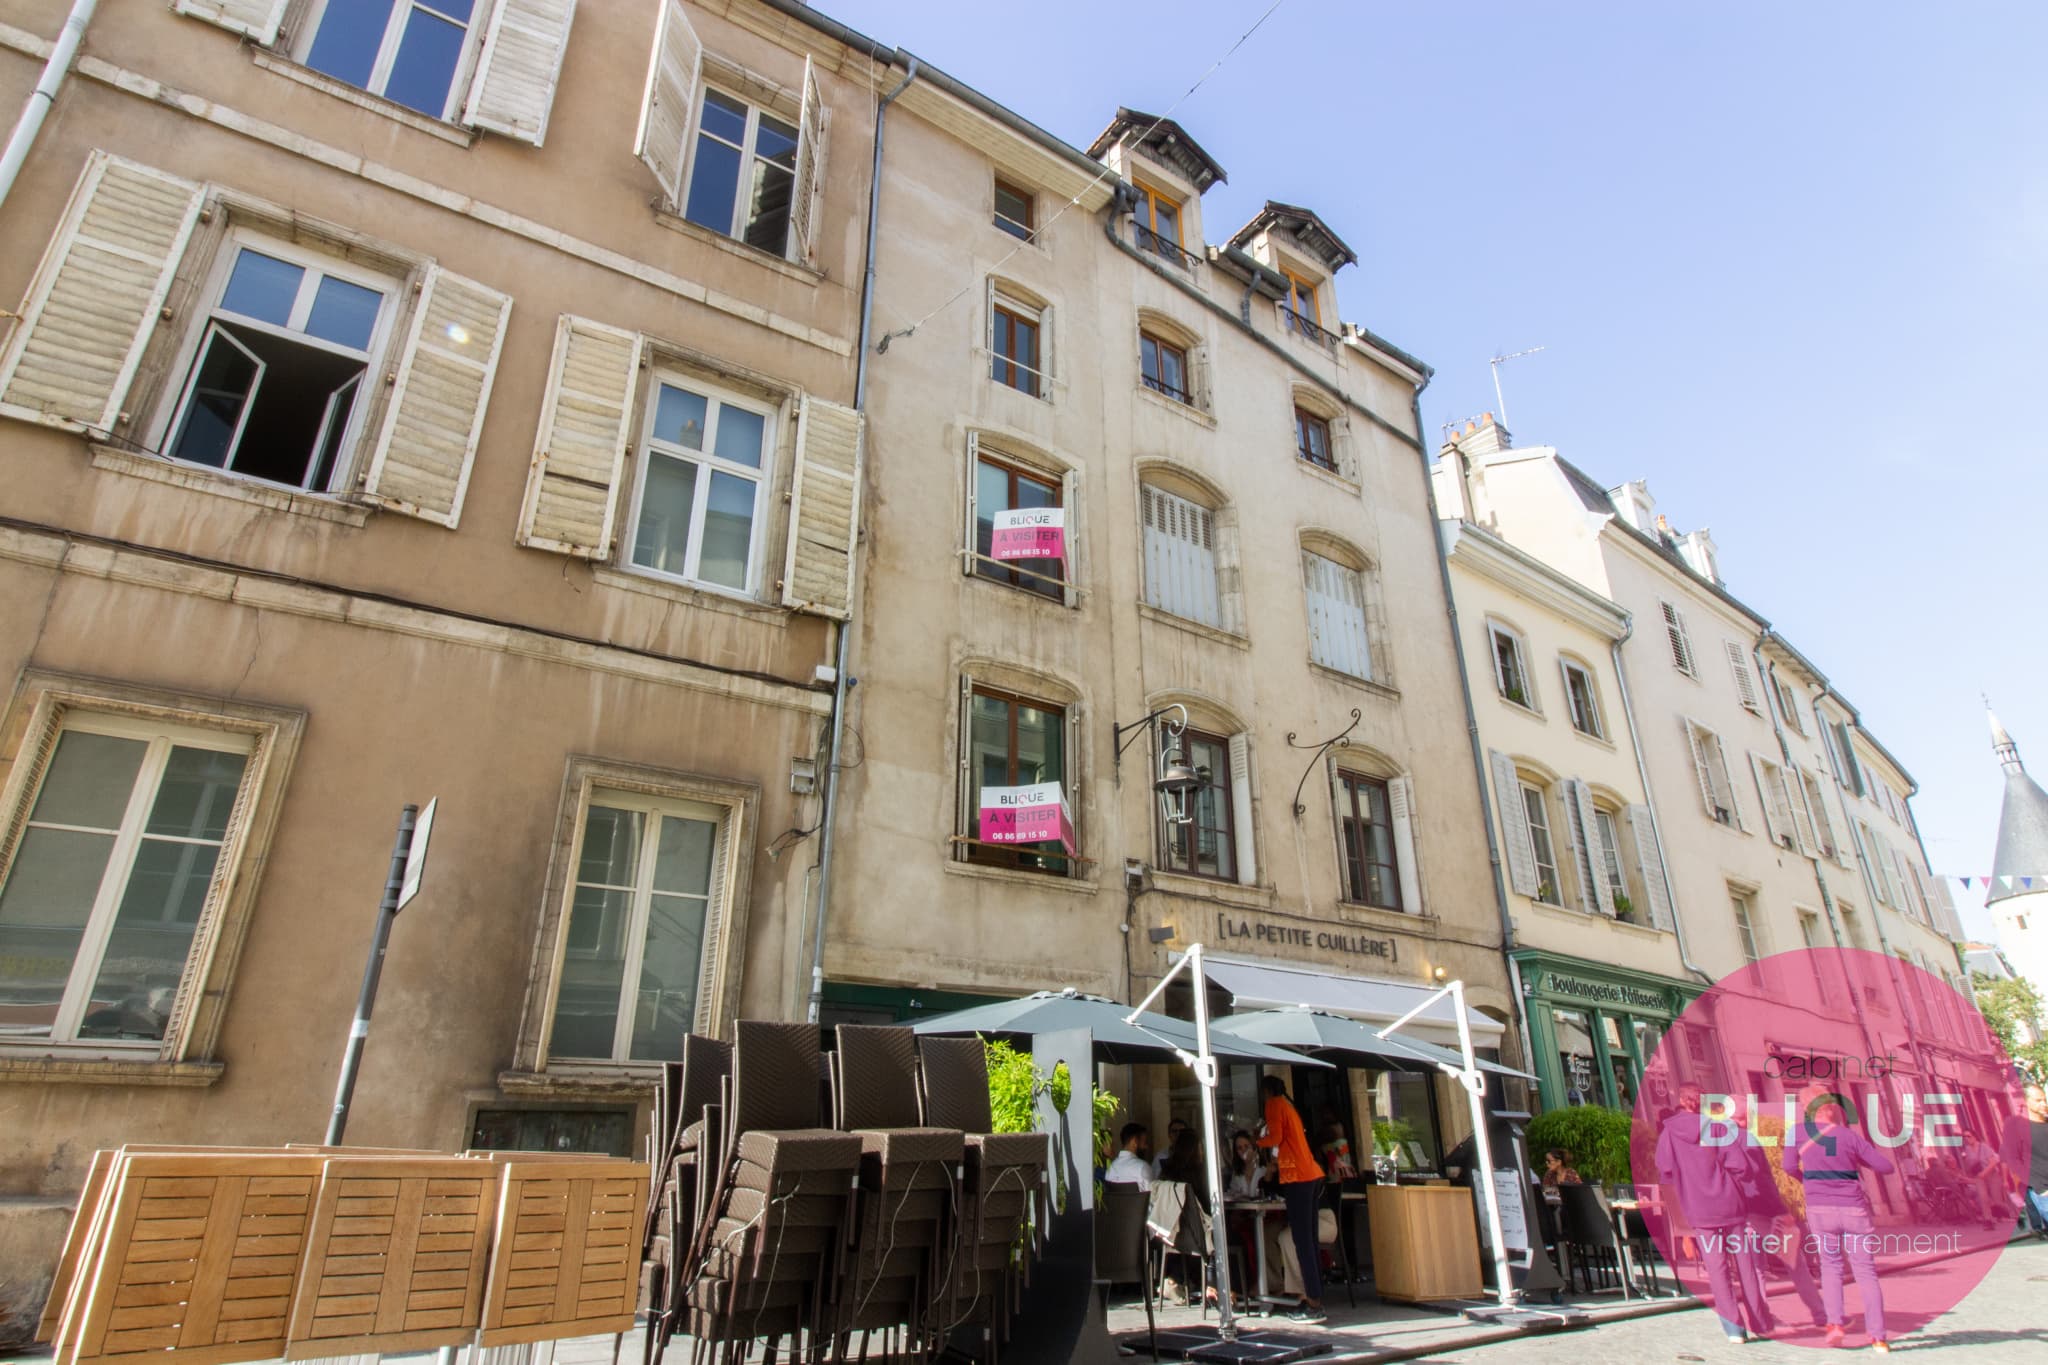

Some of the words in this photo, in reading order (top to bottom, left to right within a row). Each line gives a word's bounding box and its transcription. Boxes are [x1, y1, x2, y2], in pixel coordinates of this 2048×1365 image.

[1010, 515, 1050, 525] BLIQUE
[1013, 530, 1059, 542] VISITER
[1000, 793, 1044, 805] BLIQUE
[1003, 809, 1056, 823] VISITER
[992, 832, 1003, 840] 06
[1028, 831, 1037, 839] 15
[1038, 830, 1048, 838] 10
[1256, 923, 1313, 947] PETITE
